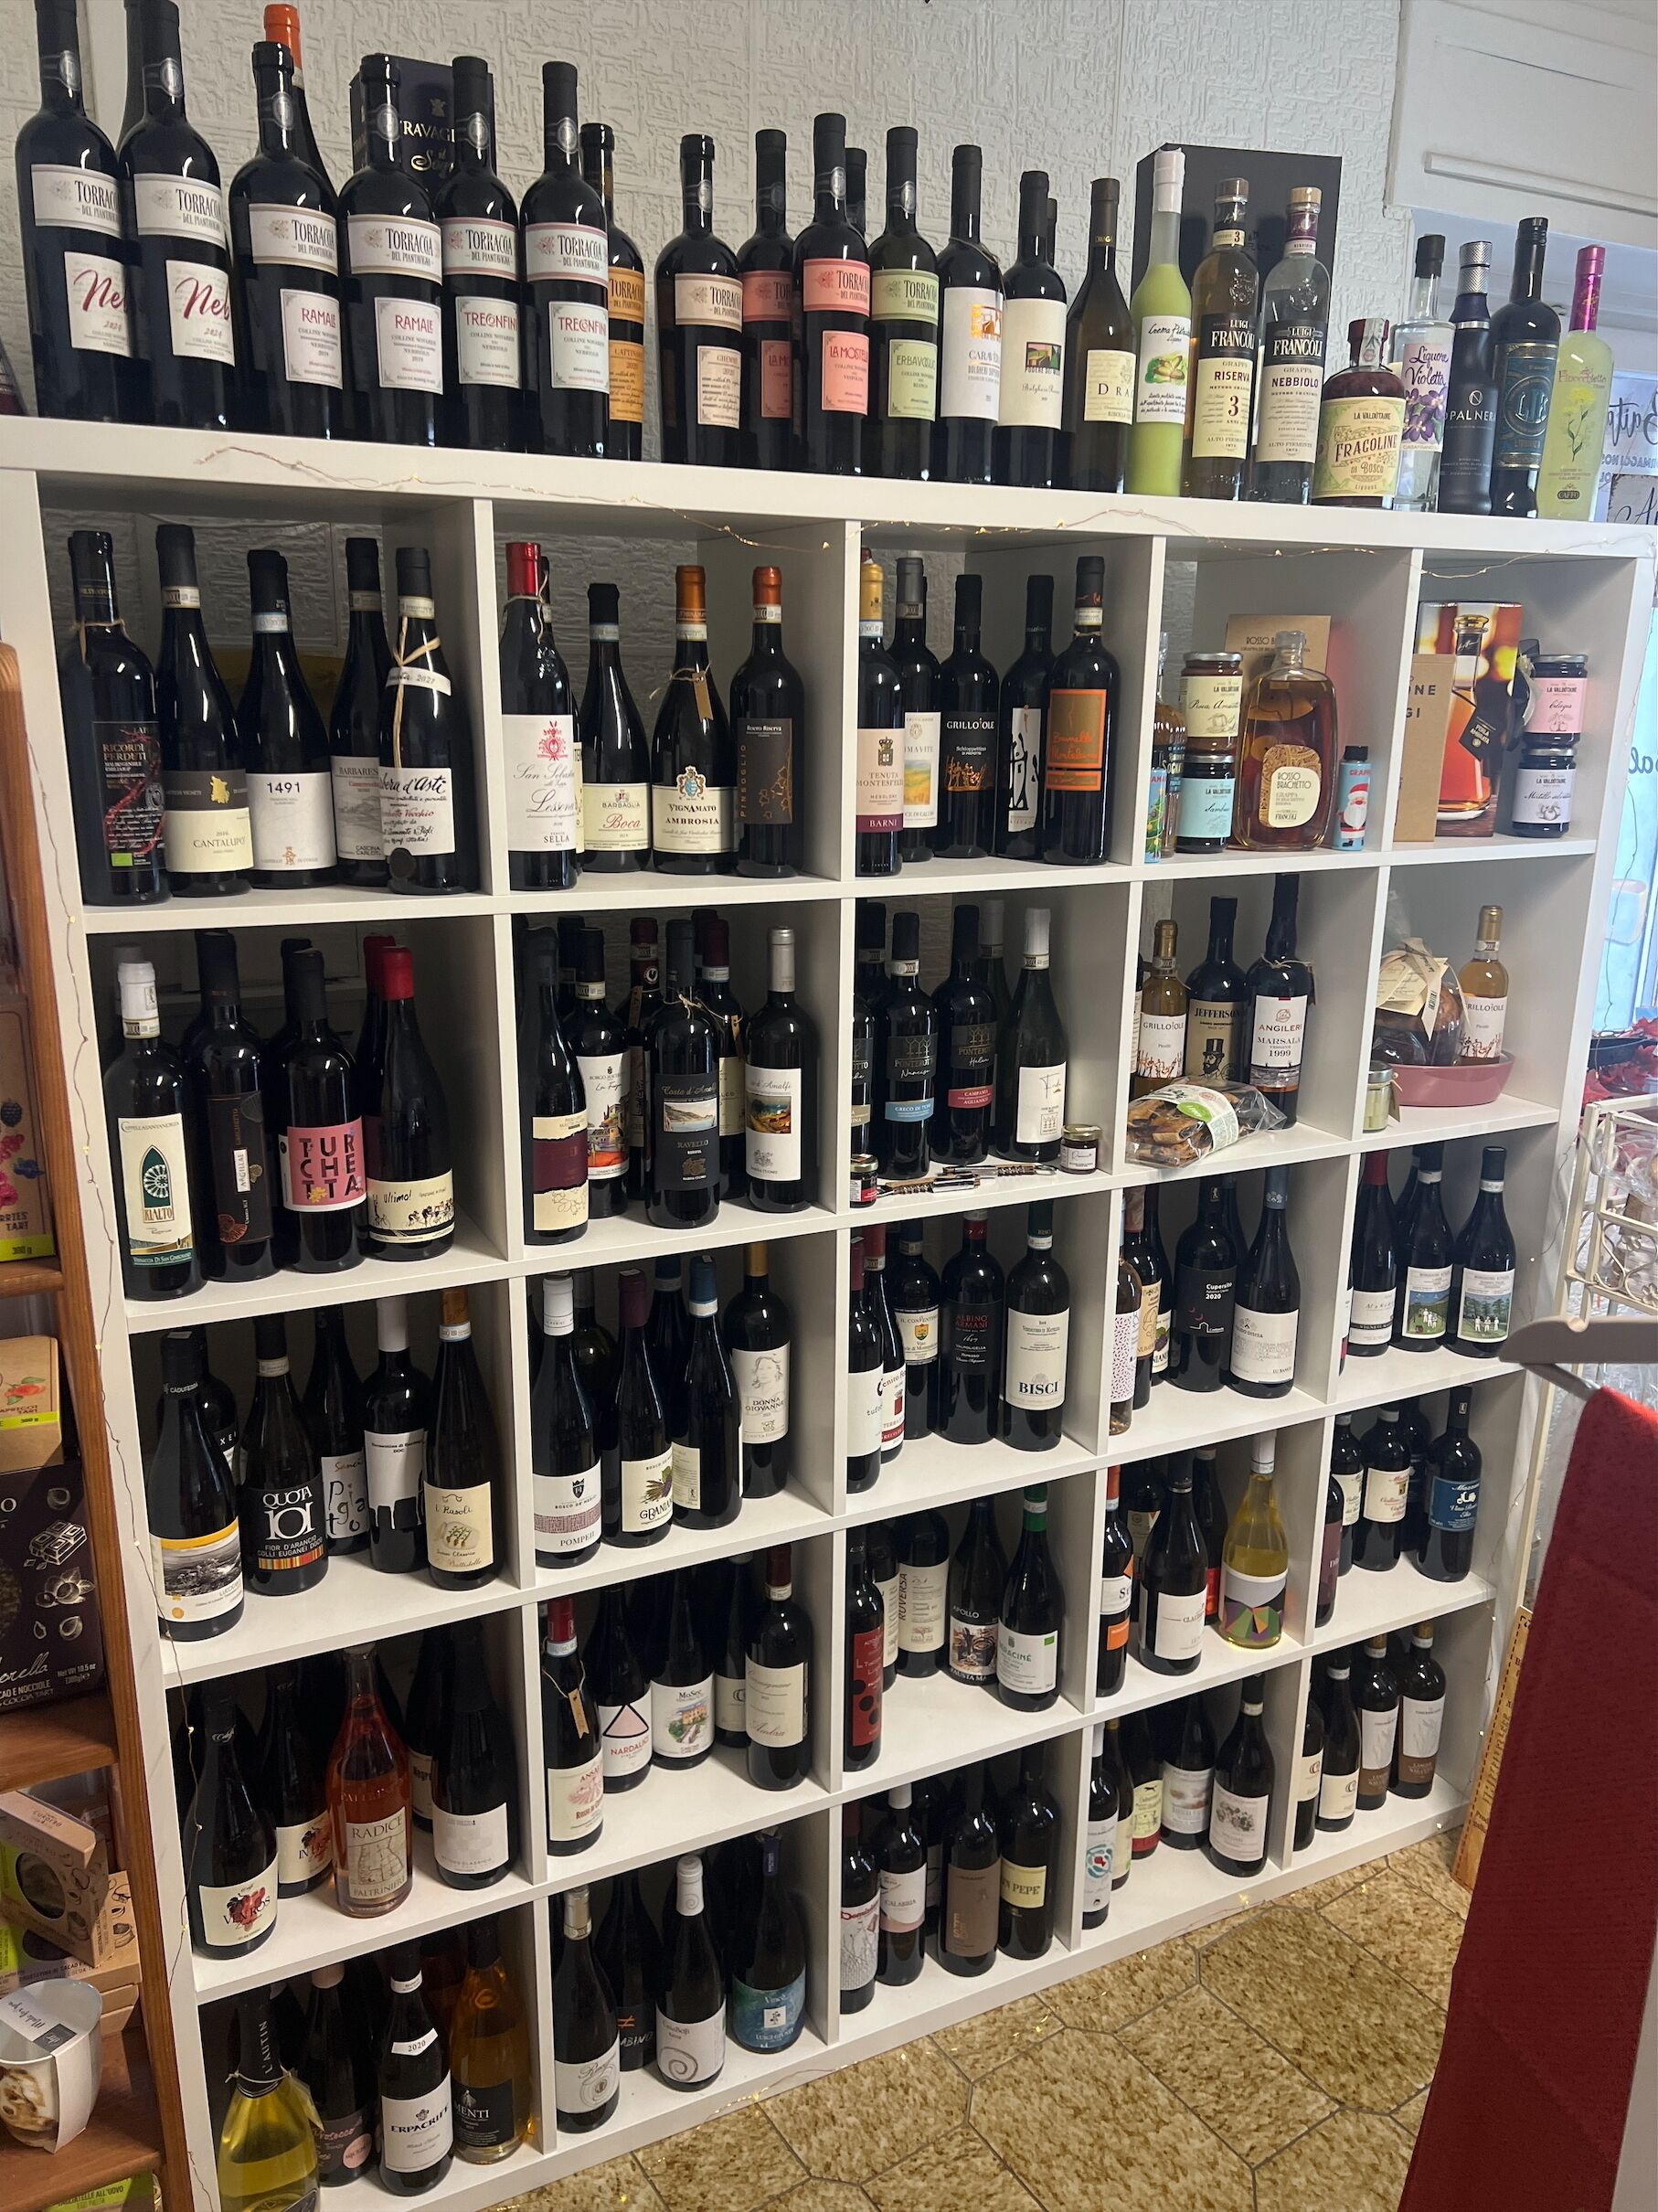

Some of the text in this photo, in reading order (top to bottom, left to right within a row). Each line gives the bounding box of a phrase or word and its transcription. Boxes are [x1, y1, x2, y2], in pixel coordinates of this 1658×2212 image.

[391, 252, 402, 262] DEL
[471, 252, 482, 261] DEL
[563, 257, 574, 267] DEL
[394, 314, 434, 335] RAMALE
[1229, 319, 1249, 329] LUIGI
[1290, 327, 1313, 336] LUIGI
[830, 346, 839, 359] LA
[1408, 345, 1450, 368] Liquore
[1214, 371, 1249, 382] RISERVA
[1404, 366, 1447, 387] Violetta
[1271, 377, 1319, 388] NEBBIOLO
[1228, 395, 1239, 417] 3
[1334, 434, 1398, 463] FRAGOLINE
[1246, 636, 1270, 645] ROSSO
[102, 743, 145, 752] RICORDI
[513, 763, 540, 780] San
[868, 772, 899, 781] TENUTA
[1277, 771, 1301, 781] ROSSO
[267, 780, 302, 794] 1491
[1276, 780, 1312, 790] BRACHETTO
[526, 788, 575, 813] Lessona
[602, 813, 642, 829] Boca
[665, 817, 719, 825] AMBROSIA
[869, 818, 898, 828] BARNI
[193, 837, 246, 848] CANTALUPO
[543, 835, 570, 844] SELLA
[1259, 1023, 1302, 1032] ANGILERI
[1257, 1037, 1302, 1045] MARSALA
[677, 1139, 709, 1149] RAVELLO
[144, 1207, 174, 1222] RIALTO
[6, 1221, 29, 1231] TART
[1206, 1282, 1233, 1291] Cupersito
[1019, 1381, 1058, 1395] BISCI
[745, 1401, 786, 1412] GIOVANNA
[753, 1397, 781, 1406] DONNA
[262, 1485, 313, 1510] QUOTA
[555, 1502, 574, 1510] BOSCO
[264, 1535, 318, 1551] FIOR D'ARANCIO
[257, 1547, 277, 1558] COLLI
[277, 1542, 308, 1557] EUGANEI
[898, 1573, 908, 1622] RUVERSA
[18, 1679, 52, 1695] NOCCIOLE
[351, 1814, 403, 1840] RADICE
[1013, 1885, 1040, 1896] PEPE
[260, 2020, 274, 2074] L'AUTIN
[408, 2039, 427, 2052] 2020
[453, 2105, 491, 2120] MENTI
